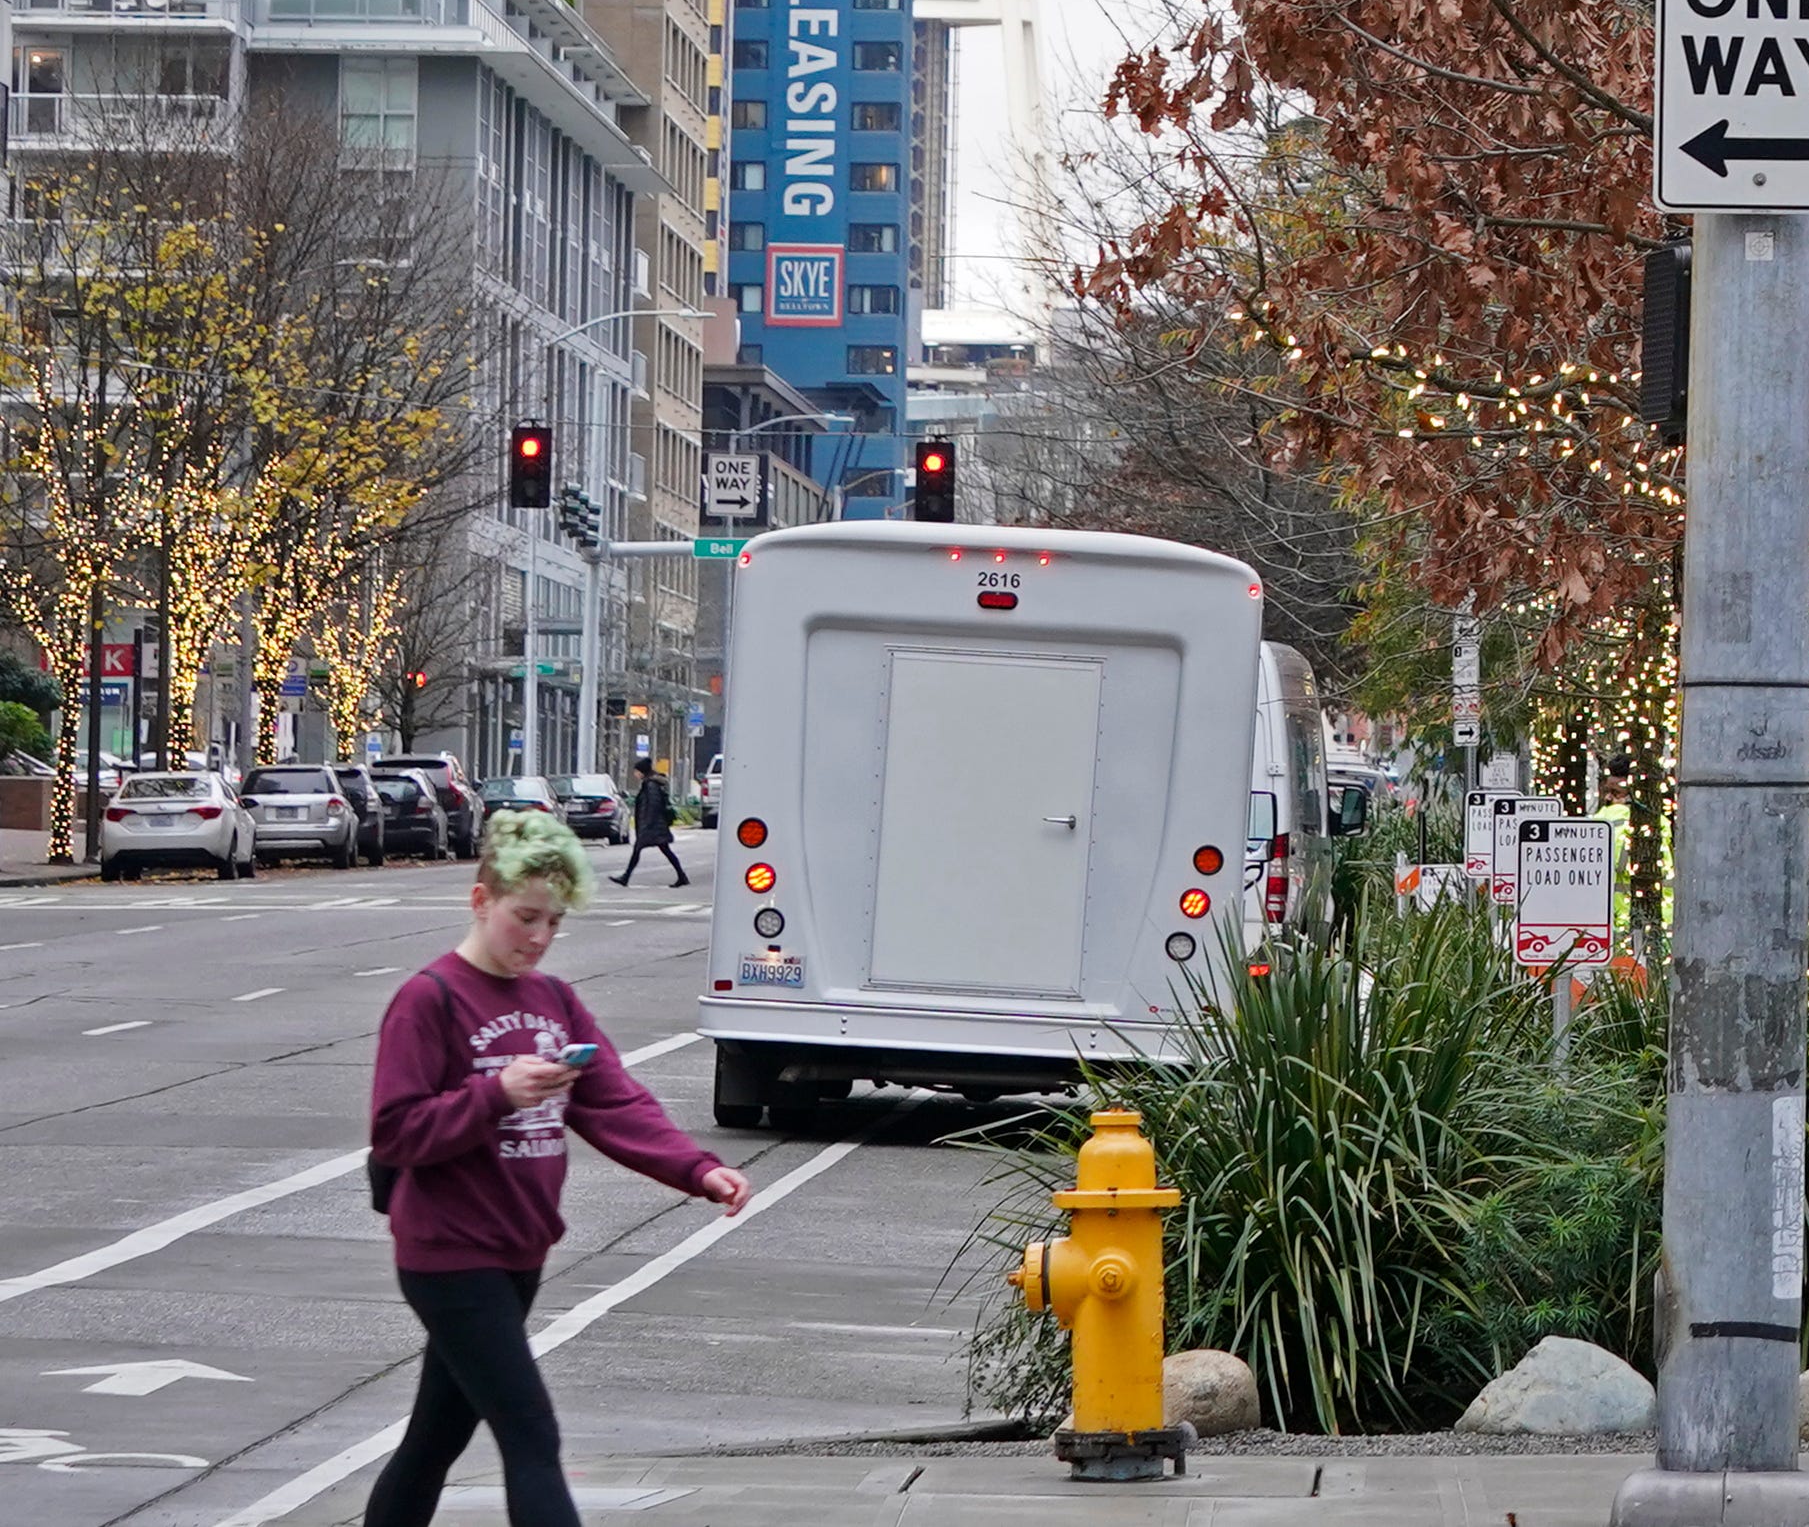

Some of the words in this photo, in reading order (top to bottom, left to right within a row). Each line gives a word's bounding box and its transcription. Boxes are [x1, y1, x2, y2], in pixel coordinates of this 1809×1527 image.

[780, 260, 830, 297] SKYE
[716, 460, 751, 474] ONE
[715, 477, 751, 491] WAY
[710, 543, 734, 554] Bell
[977, 571, 1021, 589] 2616
[1473, 795, 1481, 804] 3
[1501, 802, 1510, 812] 3
[1529, 824, 1541, 840] 3
[1554, 827, 1605, 839] MINUTE
[1499, 836, 1517, 847] LOA
[1526, 847, 1604, 863] PASSENGER
[1526, 870, 1561, 885] LOAD
[1568, 870, 1602, 885] ONLY
[742, 963, 802, 982] BXH9929
[469, 1011, 522, 1051] SALTY
